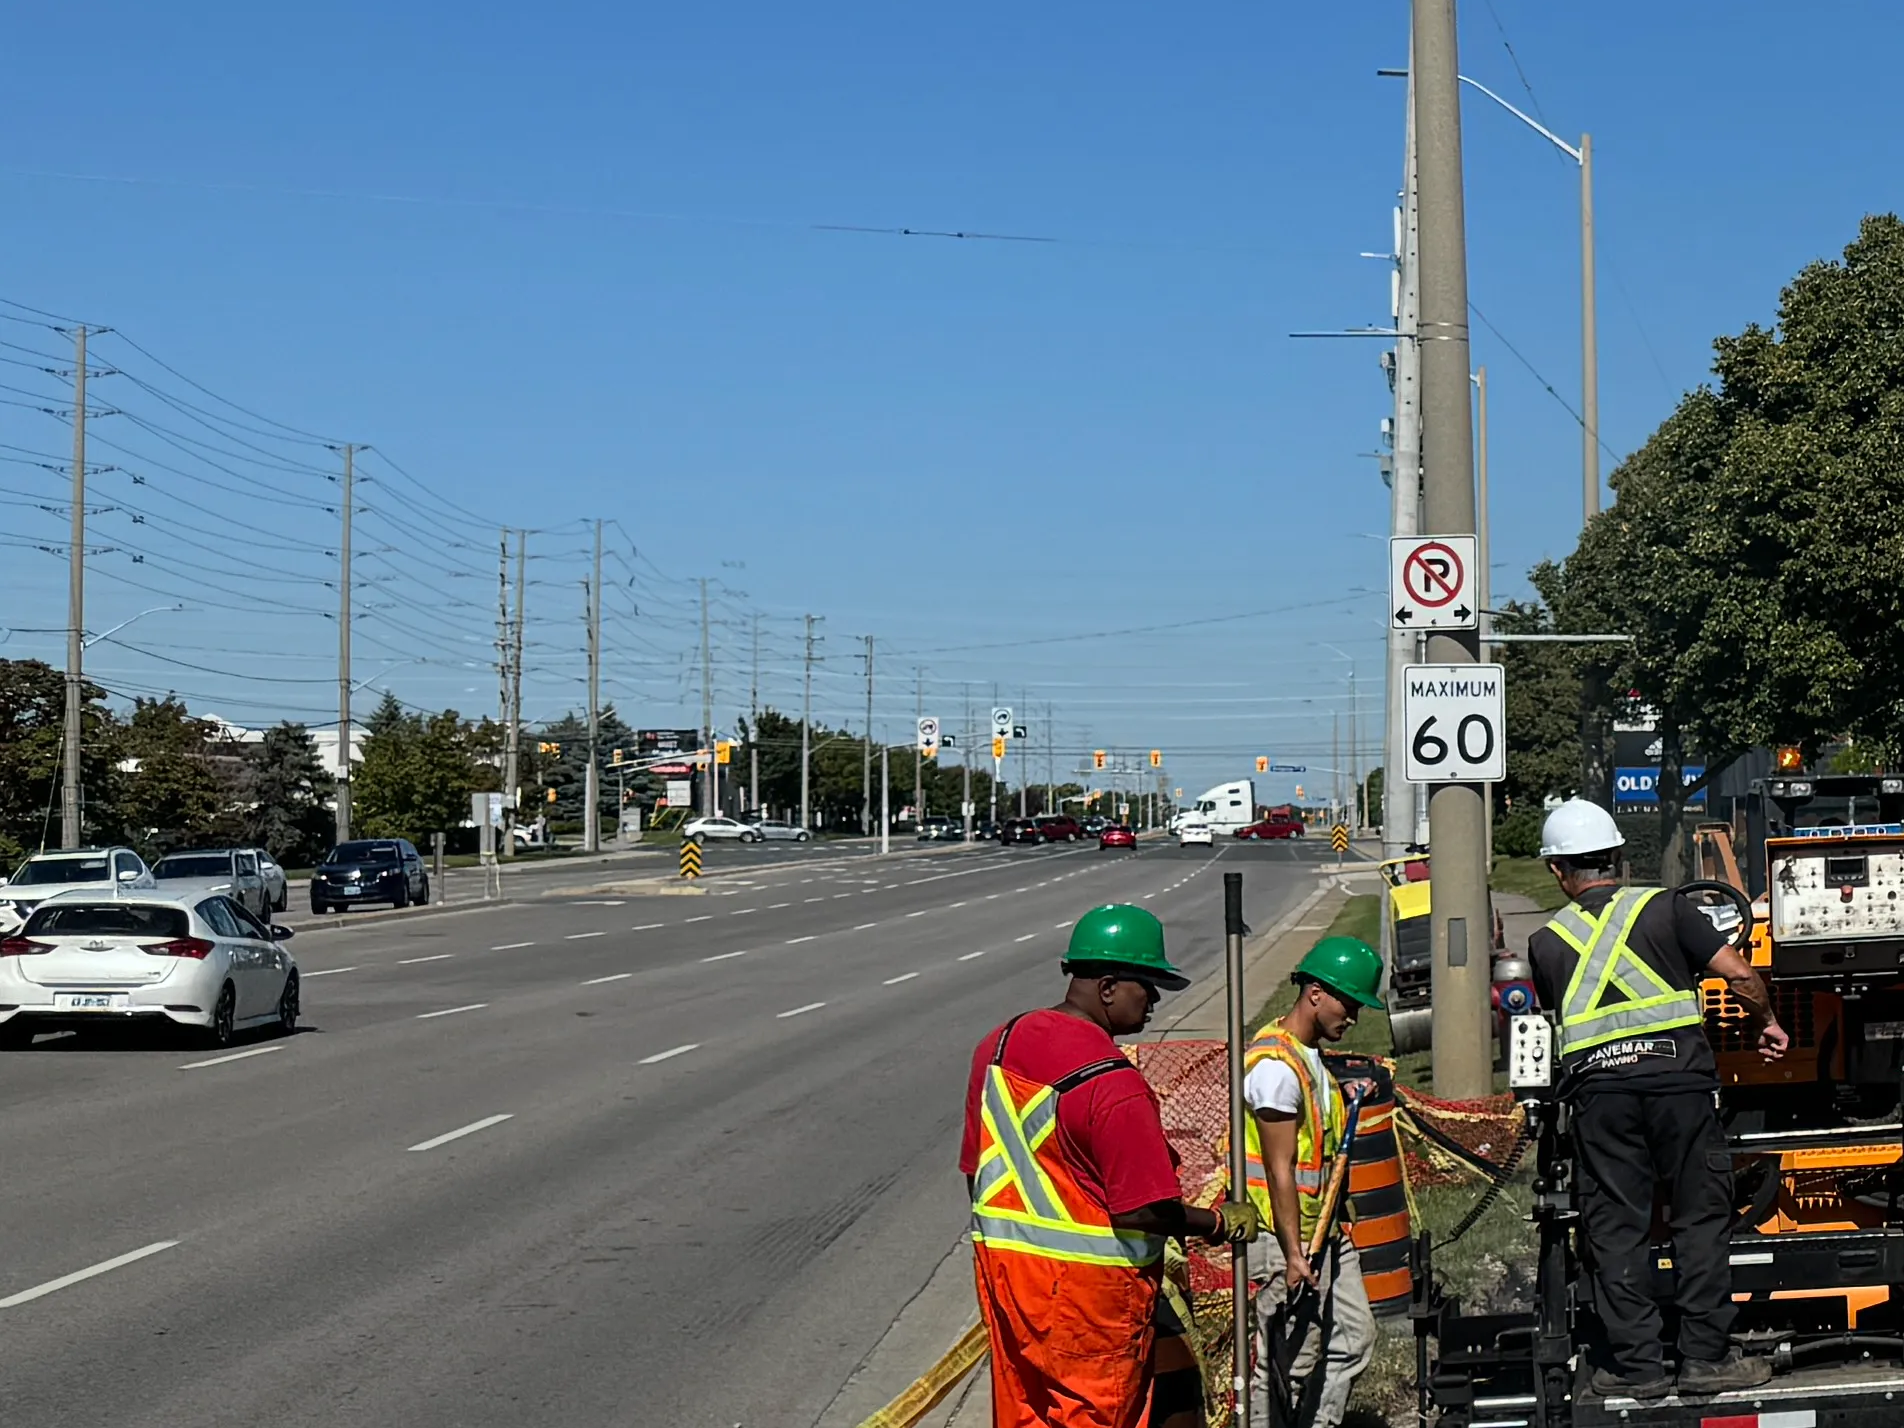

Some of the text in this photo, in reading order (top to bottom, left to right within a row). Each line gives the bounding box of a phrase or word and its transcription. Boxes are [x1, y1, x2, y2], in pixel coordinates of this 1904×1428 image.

[1411, 681, 1496, 697] MAXIMUM
[1412, 713, 1494, 765] 60
[1617, 776, 1653, 791] OLD
